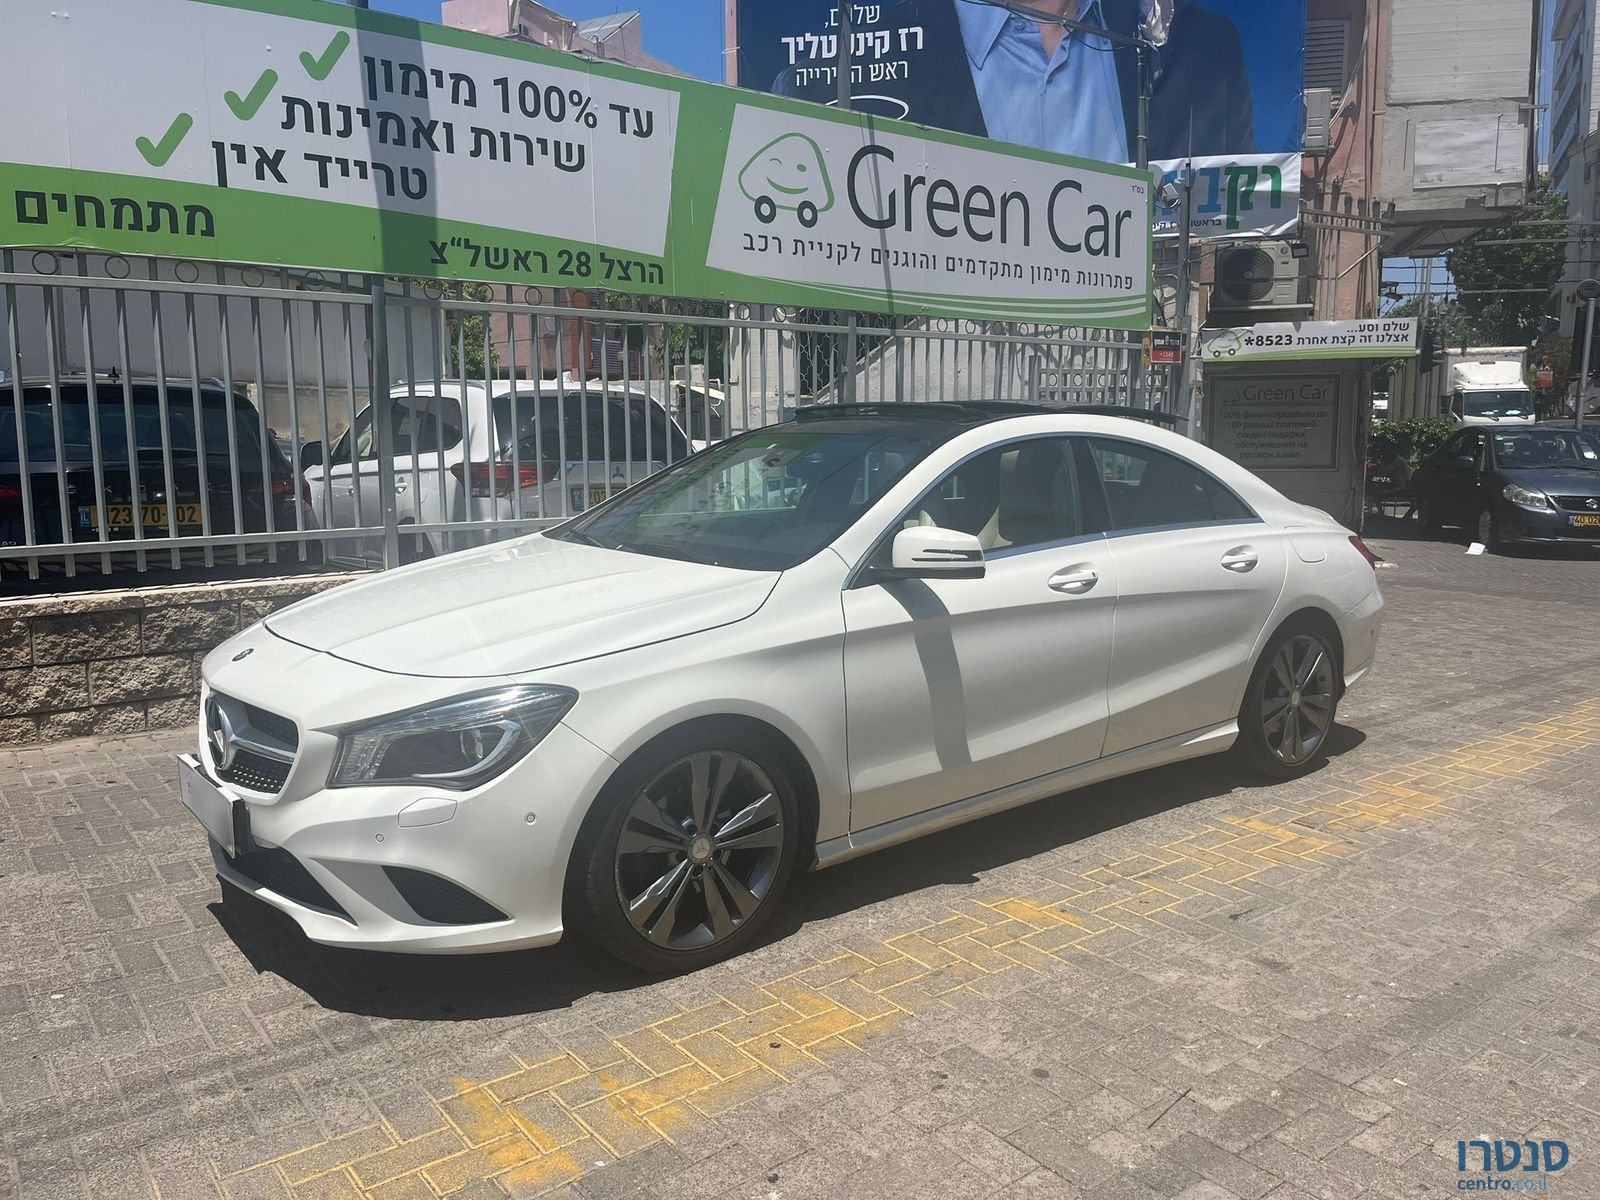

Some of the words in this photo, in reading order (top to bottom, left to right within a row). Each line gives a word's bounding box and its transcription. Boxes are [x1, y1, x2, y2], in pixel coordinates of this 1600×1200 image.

[781, 30, 890, 65] קינטליך
[898, 26, 924, 52] רז
[364, 56, 477, 108] מימון
[796, 65, 862, 87] הירייה
[868, 60, 908, 82] ראש
[493, 77, 598, 129] 100%
[281, 95, 455, 155] ואמינות
[609, 103, 653, 139] עד
[470, 126, 585, 173] שירות
[212, 140, 288, 188] אין
[304, 153, 428, 200] טרייד
[15, 190, 215, 238] מתמחים
[847, 144, 1030, 247] Green
[1047, 179, 1132, 259] Car
[743, 233, 782, 254] רכב
[792, 239, 861, 266] לקניית
[557, 249, 592, 277] 28
[600, 252, 664, 284] הרצל
[871, 248, 936, 270] והוגנים
[946, 256, 1023, 281] מתקדמים
[1030, 265, 1070, 285] מימון
[1077, 271, 1133, 290] פתרונות
[1360, 335, 1373, 343] זה
[1376, 332, 1410, 343] אצלנו
[1383, 321, 1410, 332] שלם
[1296, 336, 1328, 346] אחרת
[1331, 335, 1356, 347] קצת
[1243, 385, 1295, 401] Green
[1299, 384, 1330, 400] Car
